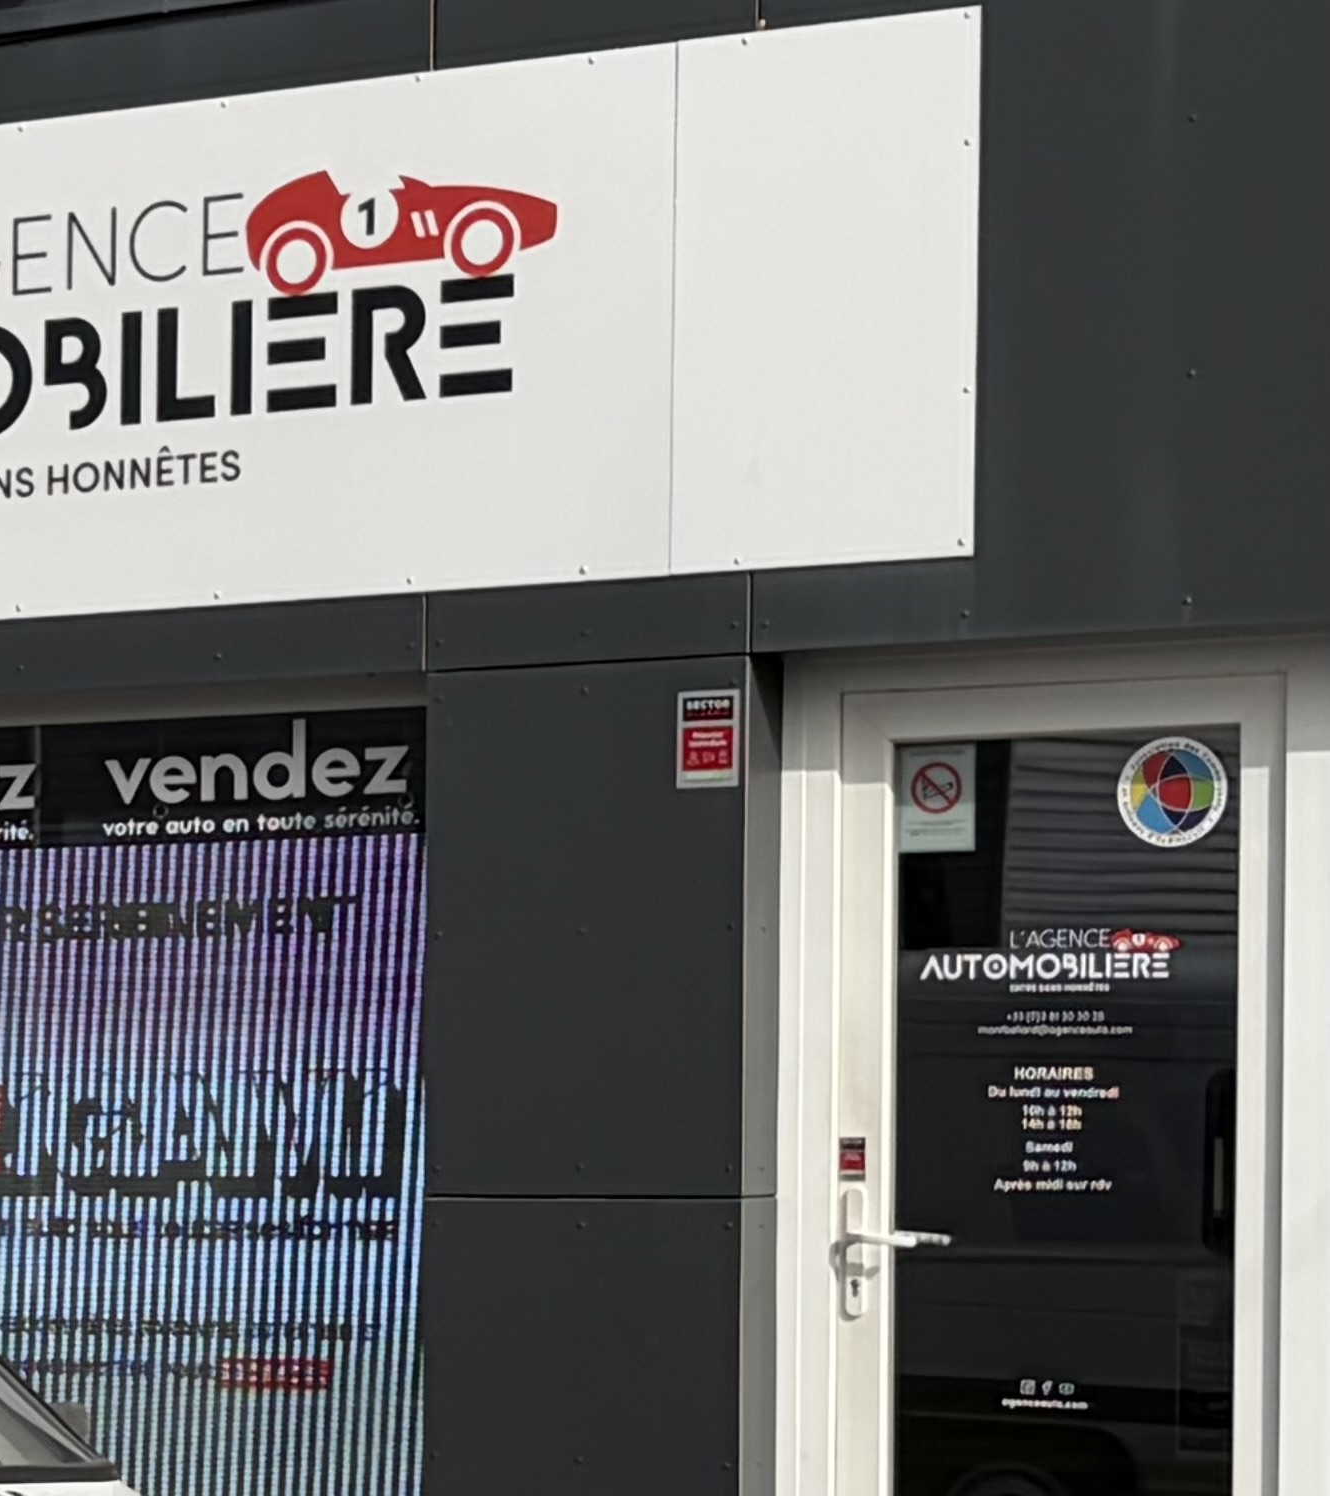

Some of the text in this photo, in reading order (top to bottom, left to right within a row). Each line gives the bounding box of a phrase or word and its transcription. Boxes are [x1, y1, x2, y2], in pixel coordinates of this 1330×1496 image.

[357, 200, 375, 235] 1
[46, 445, 242, 497] HONNÊTES
[104, 718, 409, 805] vendez
[102, 804, 420, 837] votre auto en toute sérénité.
[1009, 928, 1112, 950] L'AGENCE
[1013, 1066, 1094, 1080] HORAIRES
[987, 1085, 1120, 1099] Du lundi au vendredi
[1025, 1140, 1074, 1154] Samedi
[993, 1177, 1032, 1193] Après
[1036, 1177, 1063, 1191] midi
[1066, 1180, 1088, 1191] sur
